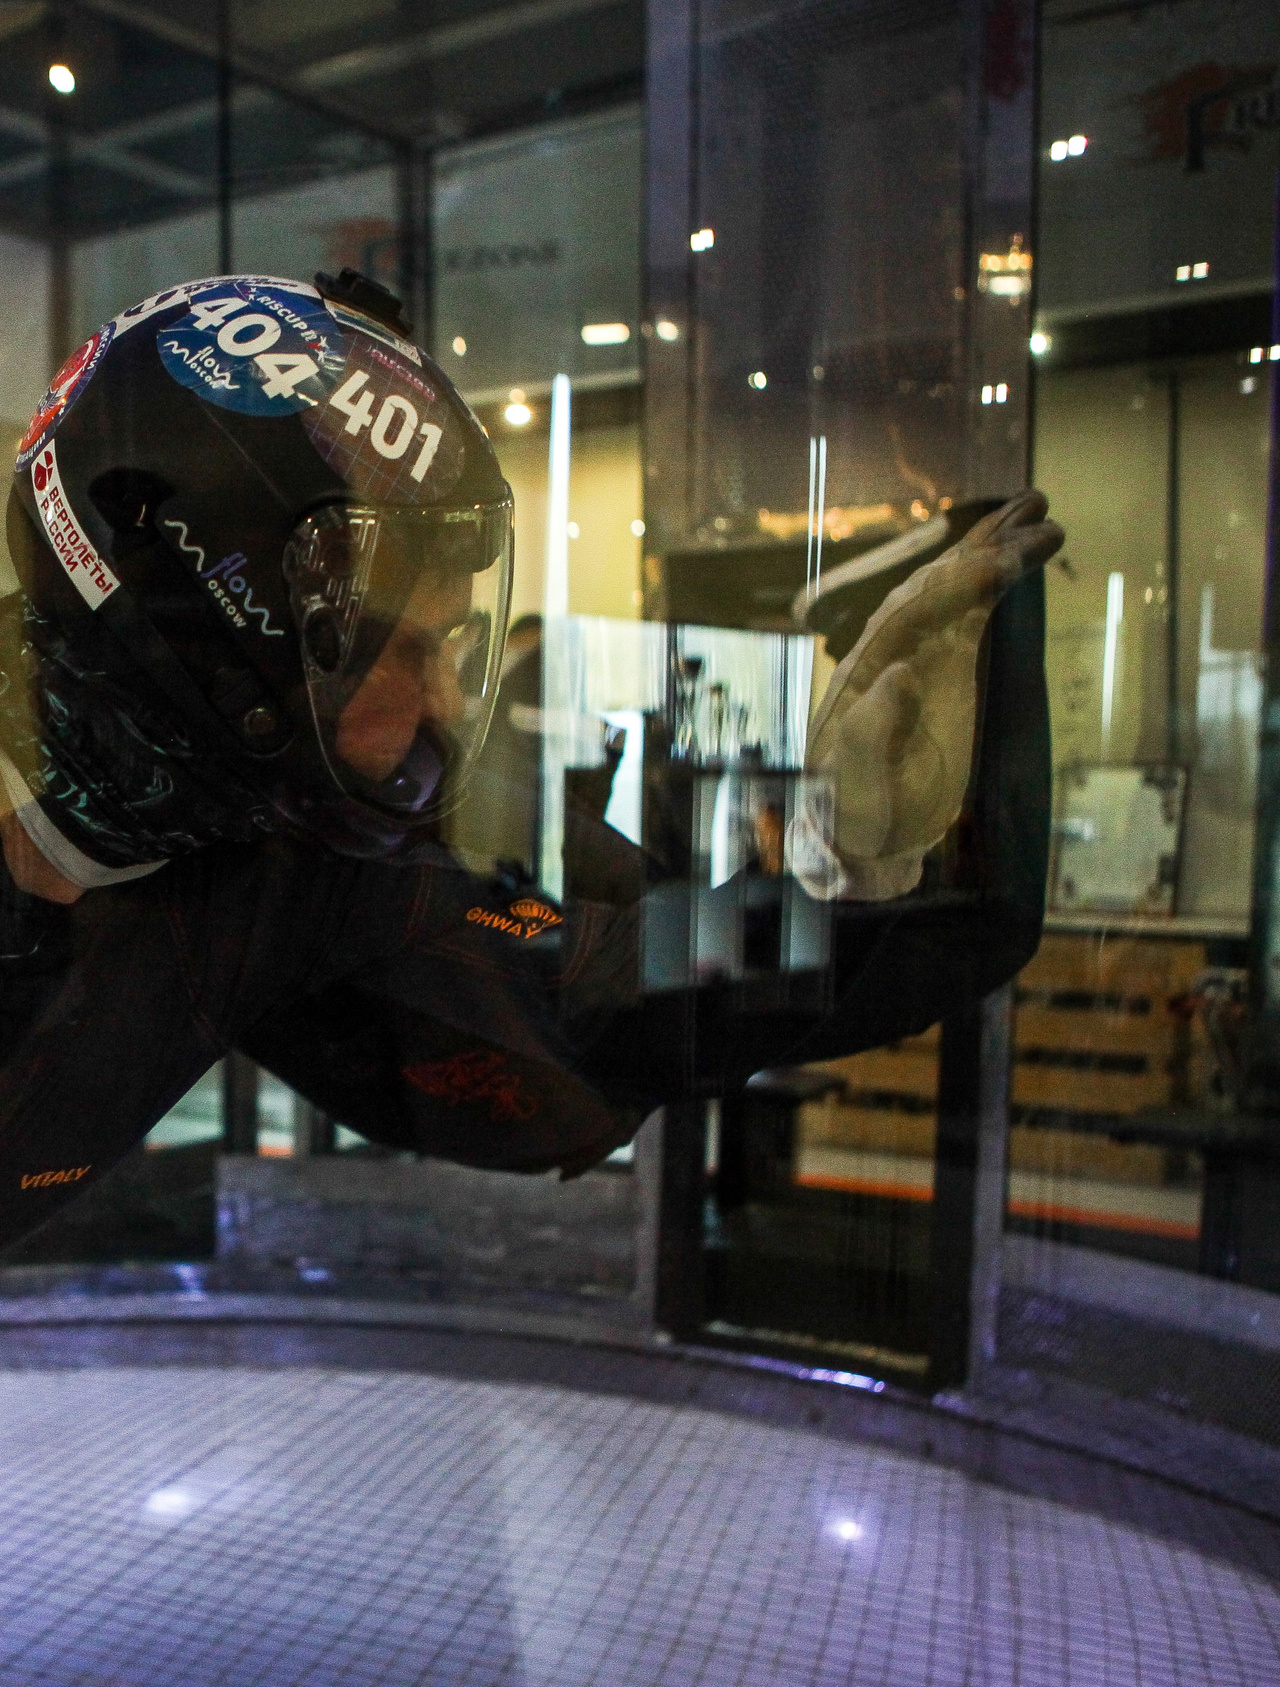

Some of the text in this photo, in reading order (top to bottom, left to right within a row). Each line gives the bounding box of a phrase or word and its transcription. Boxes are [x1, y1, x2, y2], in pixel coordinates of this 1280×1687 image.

[189, 297, 320, 399] 404
[329, 370, 443, 483] 401
[49, 486, 113, 595] ВЕРТОЛЕТЫ
[20, 1165, 93, 1190] VITALY
